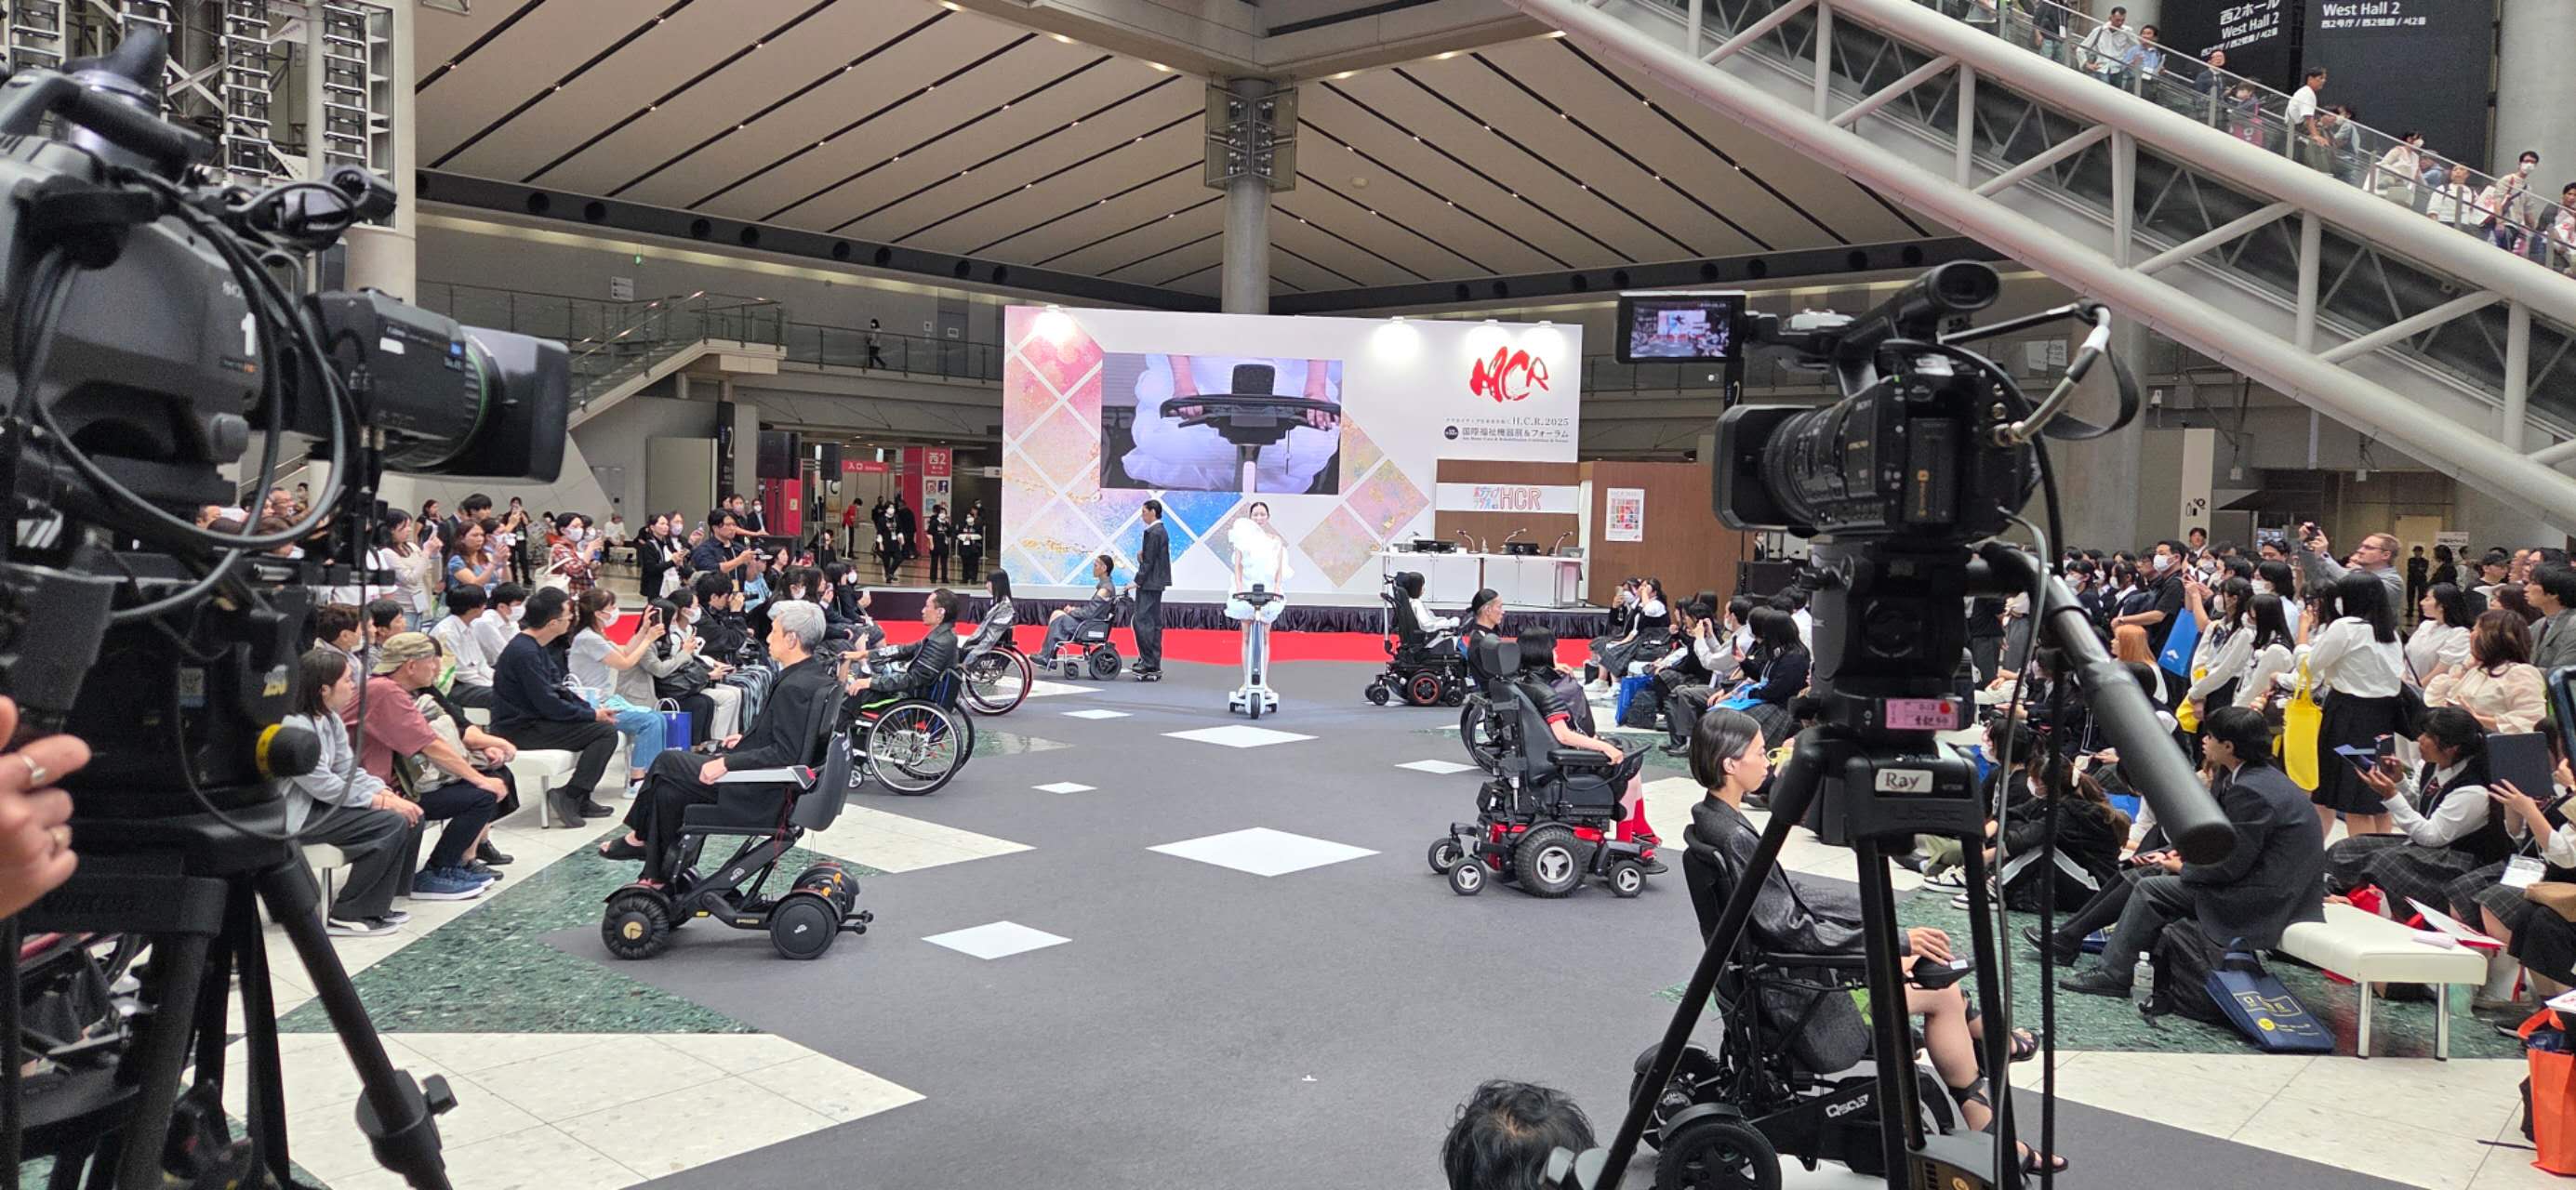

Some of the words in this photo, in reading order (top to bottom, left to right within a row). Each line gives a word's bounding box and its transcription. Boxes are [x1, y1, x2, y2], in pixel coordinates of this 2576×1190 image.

[2323, 4, 2357, 17] West
[2360, 1, 2388, 16] Hall
[2391, 2, 2400, 15] 2
[2222, 22, 2248, 39] West
[2249, 13, 2270, 32] Hall
[2272, 11, 2280, 25] 2
[1500, 487, 1542, 510] HCR
[1885, 772, 1920, 790] Ray
